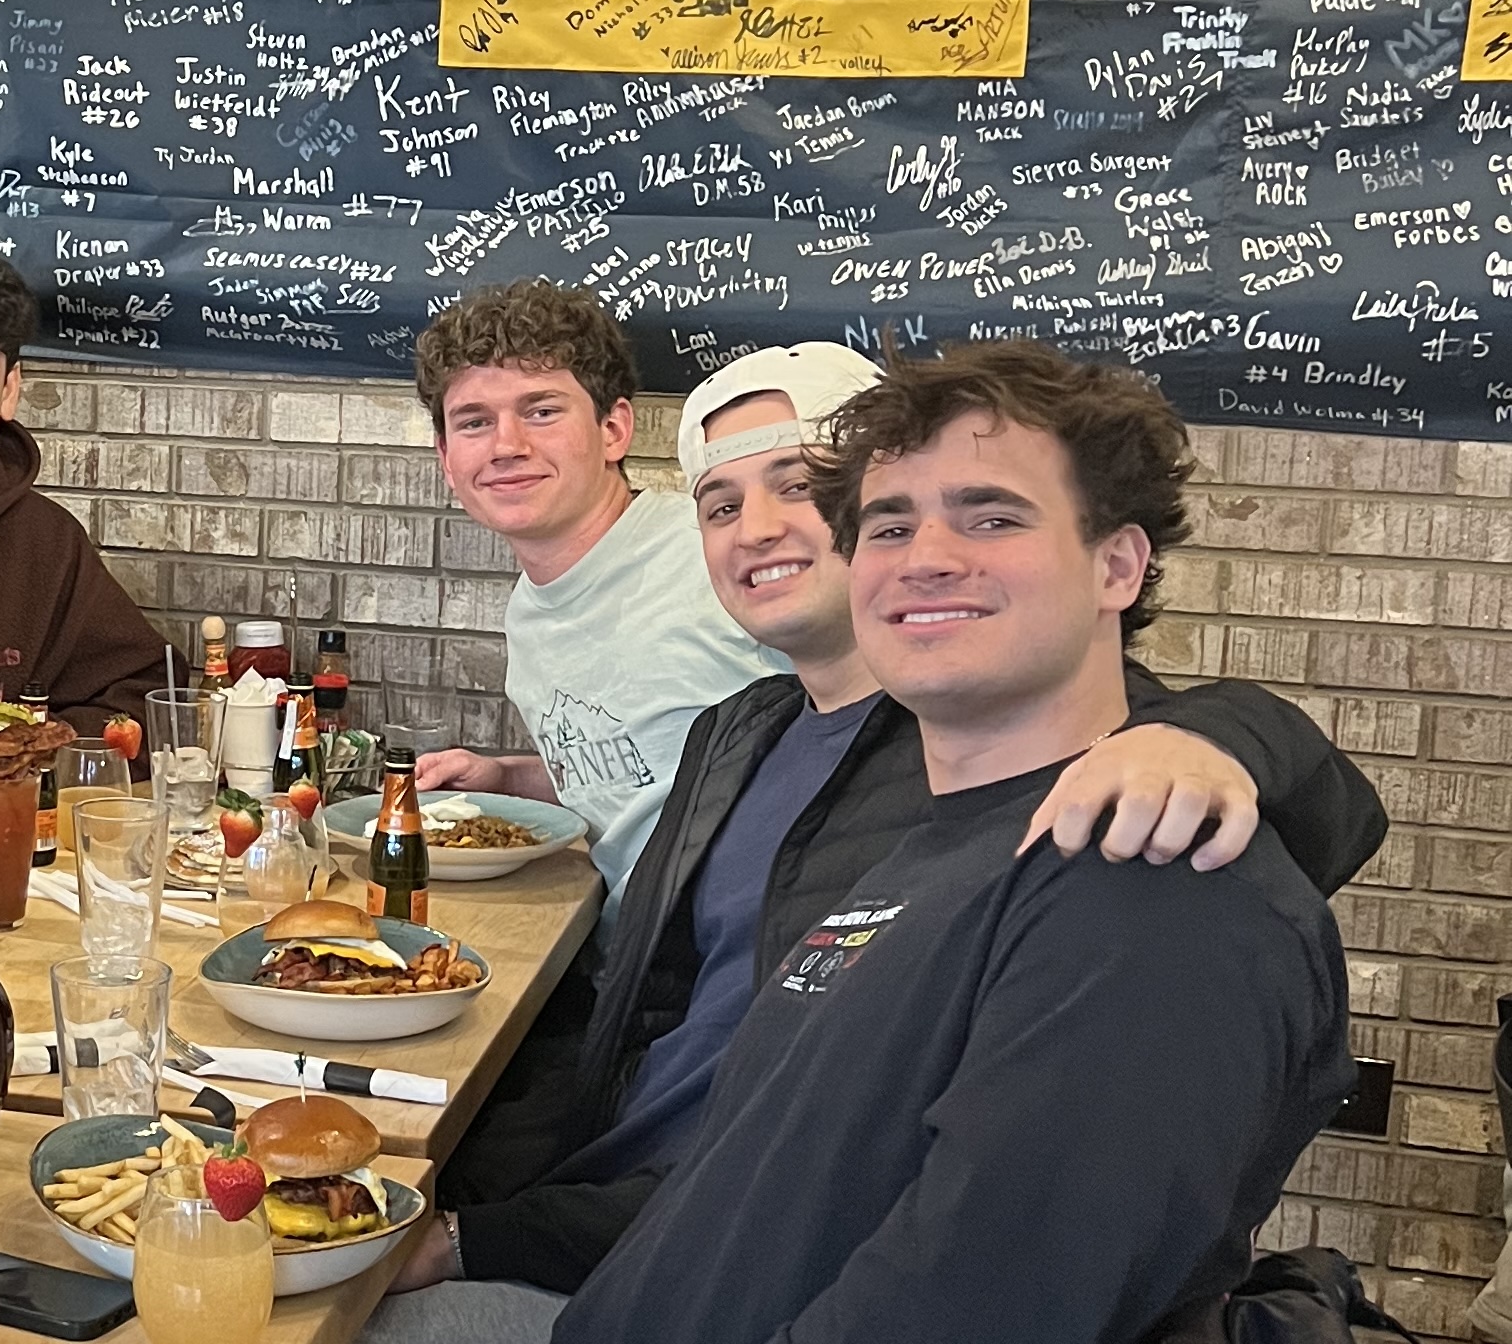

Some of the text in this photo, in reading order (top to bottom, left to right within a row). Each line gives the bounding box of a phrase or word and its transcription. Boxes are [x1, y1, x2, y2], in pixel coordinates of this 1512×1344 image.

[174, 56, 247, 88] Justin
[62, 77, 152, 107] Rideout
[373, 74, 471, 122] Kent
[956, 99, 1046, 123] MANSON
[378, 122, 479, 153] Johnson
[232, 166, 335, 200] Marshall
[1011, 151, 1173, 186] Sierra Sargent
[514, 169, 618, 217] Emerson
[1353, 206, 1451, 231] Emerson
